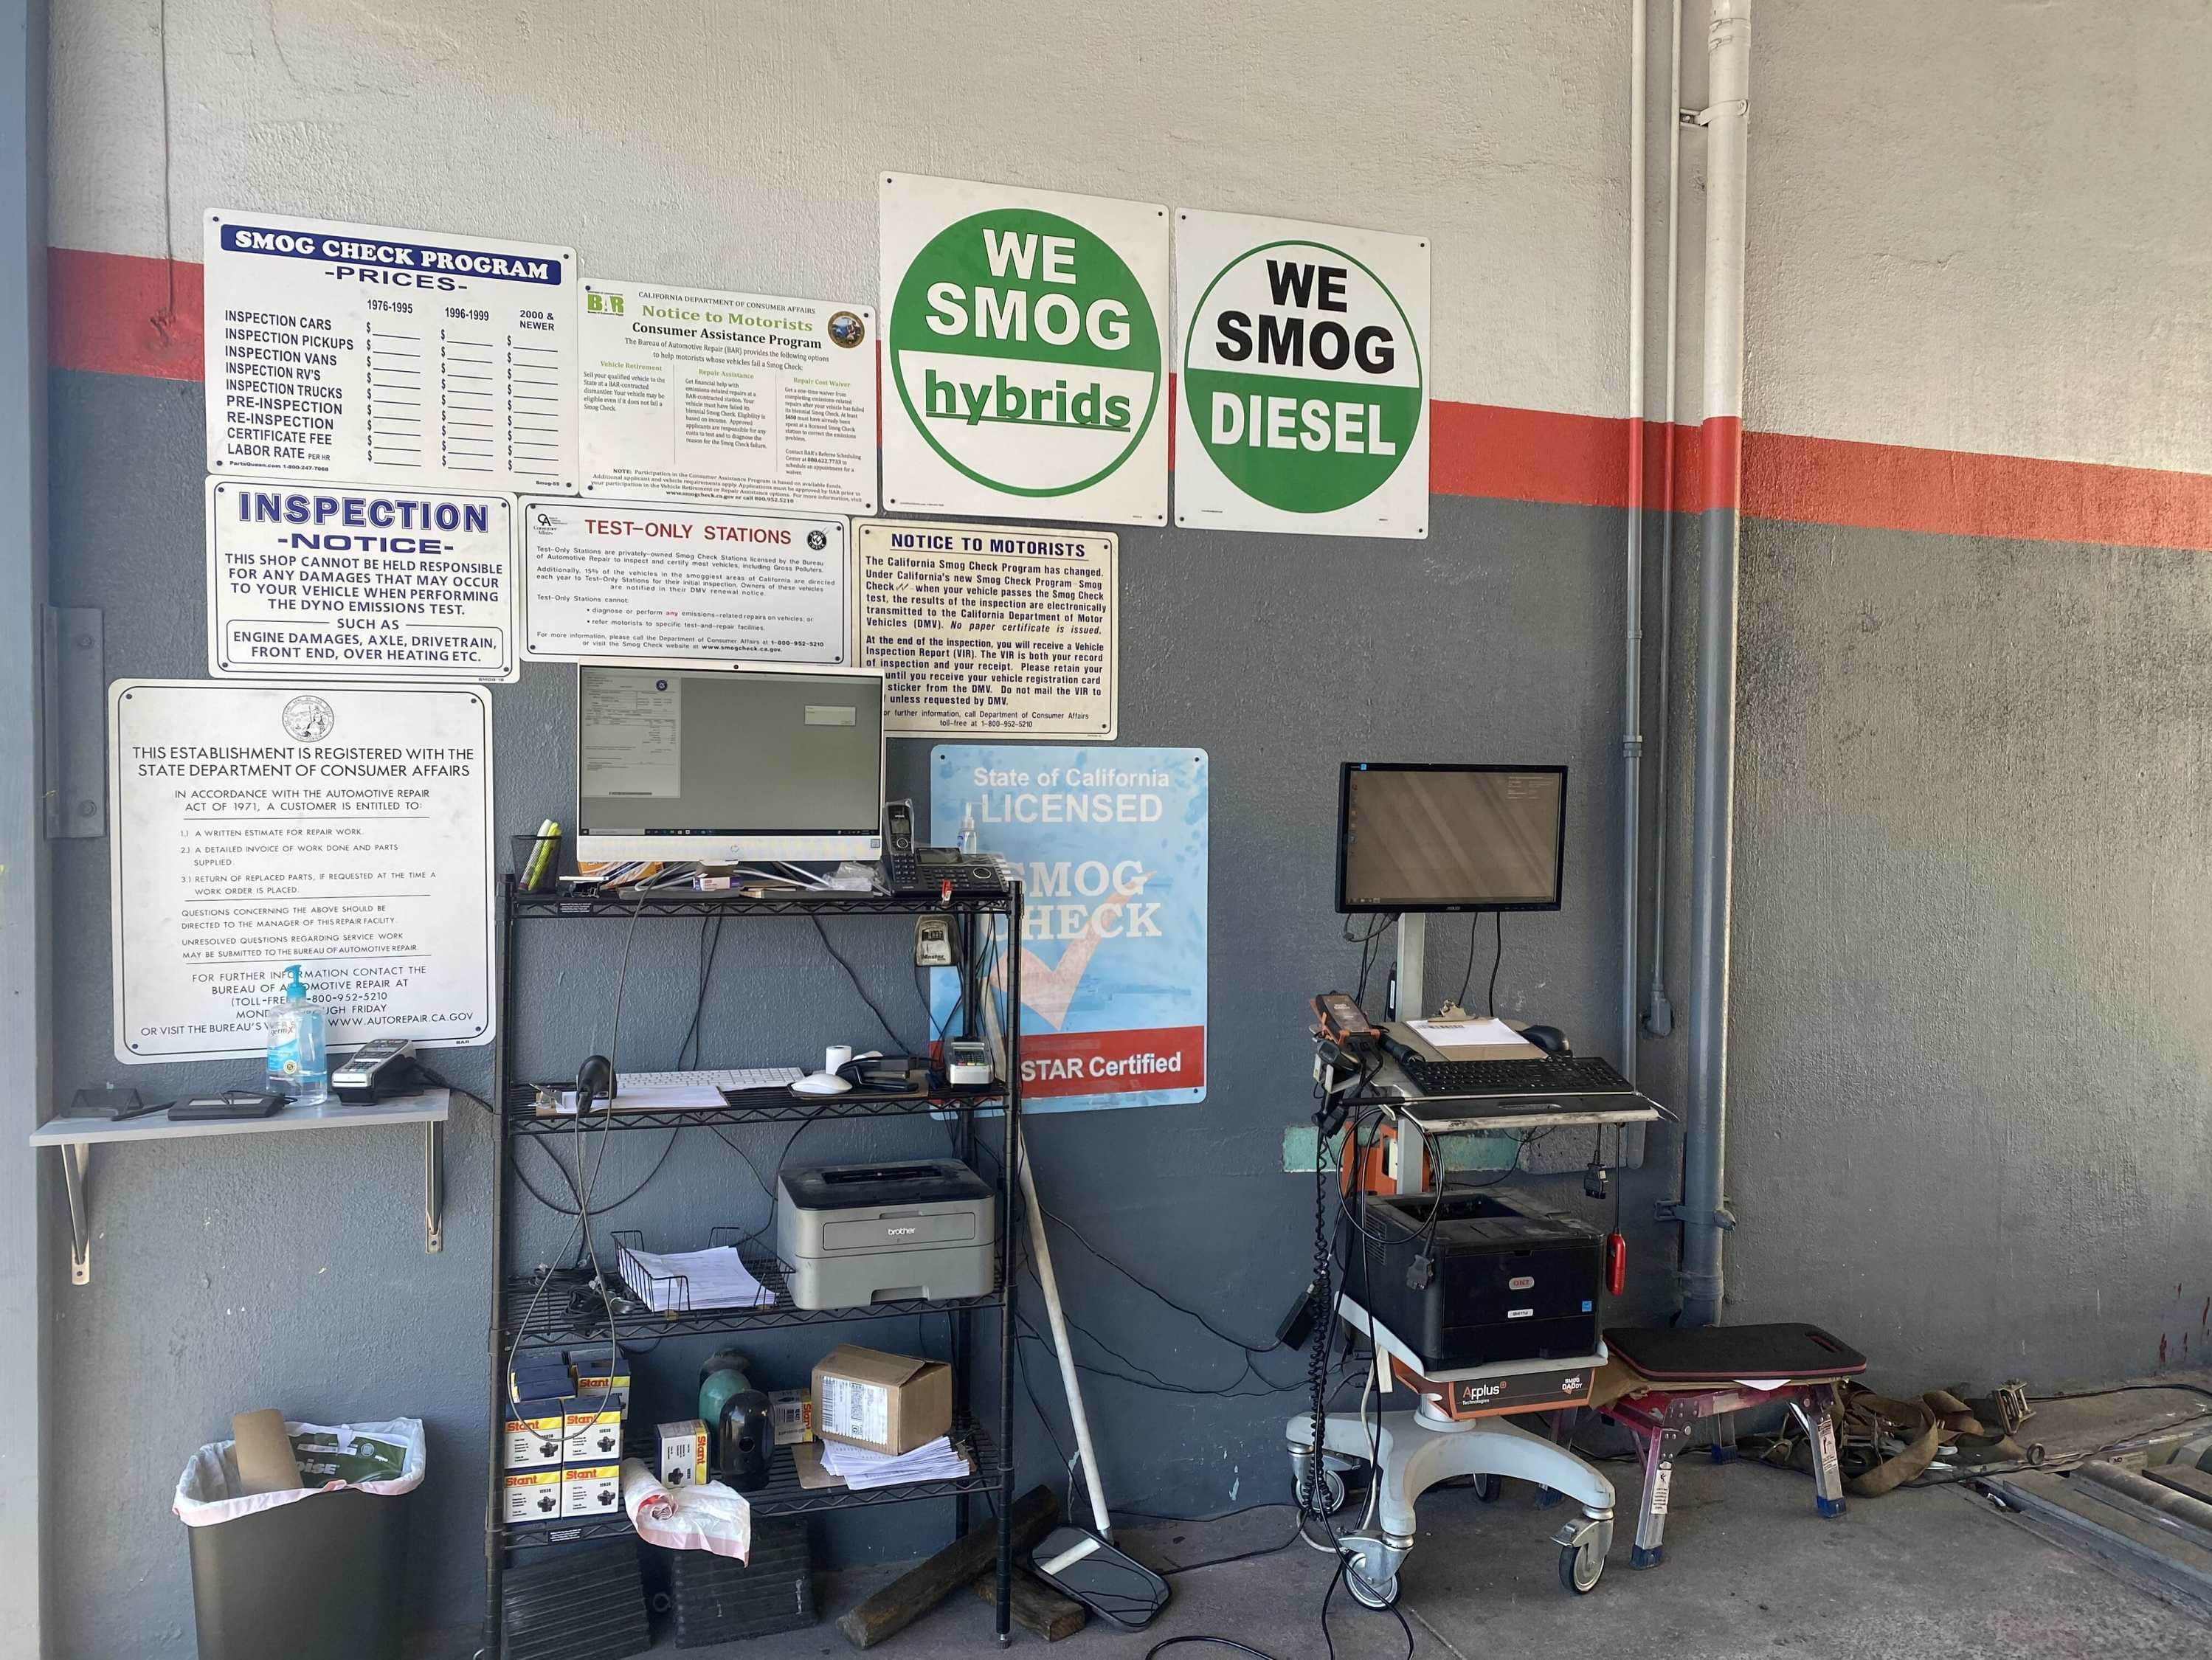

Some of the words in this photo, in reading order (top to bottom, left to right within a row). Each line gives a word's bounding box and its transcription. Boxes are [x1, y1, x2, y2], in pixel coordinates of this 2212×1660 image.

[235, 231, 315, 254] SMOG
[322, 240, 414, 265] CHECK
[421, 251, 547, 279] PROGRAM
[983, 229, 1076, 284] WE
[325, 266, 466, 291] -PRICES-
[1266, 260, 1347, 313] WE
[367, 299, 412, 313] 1976-1995
[639, 291, 682, 301] CALIFORNIA
[685, 296, 733, 305] DEPARTMENT
[747, 302, 785, 311] CONSUMER
[226, 310, 295, 327] INSPECTION
[300, 317, 331, 330] CARS
[445, 307, 488, 321] 1996-1999
[520, 310, 543, 319] 2000
[643, 305, 699, 320] Notice
[706, 312, 722, 322] to
[729, 314, 812, 331] Motorists
[926, 283, 1130, 350] SMOG
[520, 320, 554, 331] NEWER
[226, 328, 298, 345] INSPECTION
[303, 335, 353, 350] PICKUPS
[633, 322, 697, 336] Consumer
[700, 328, 765, 343] Assistance
[770, 334, 820, 349] Program
[1216, 311, 1394, 374] SMOG
[226, 345, 300, 362] INSPECTION
[305, 353, 336, 365] VANS
[226, 362, 292, 378] INSPECTION
[297, 368, 320, 380] RV'S
[626, 362, 661, 371] Retirement
[227, 379, 294, 395] INSPECTION
[297, 384, 342, 398] TRUCKS
[227, 395, 342, 414] PRE-INSPECTION
[926, 370, 1130, 432] hybrids
[227, 412, 333, 429] RE-INSPECTION
[1212, 392, 1395, 455] DIESEL
[227, 427, 305, 443] CERTIFICATE
[310, 433, 331, 445] FEE
[228, 443, 270, 456] LABOR
[274, 446, 304, 458] RATE
[239, 491, 488, 533] INSPECTION
[584, 519, 692, 538] TEST-ONLY
[705, 526, 791, 544] STATIONS
[278, 533, 453, 554] -NOTICE-
[892, 533, 953, 549] NOTICE
[961, 537, 981, 551] TO
[990, 539, 1085, 557] MOTORISTS
[225, 553, 255, 564] THIS
[260, 555, 296, 565] SHOP
[301, 556, 359, 568] CANNOT
[364, 559, 378, 569] BE
[383, 560, 415, 570] HELD
[421, 561, 502, 574] RESPONSIBLE
[866, 556, 882, 565] The
[888, 557, 934, 567] California
[939, 559, 964, 571] Smog
[970, 561, 998, 571] Check
[1002, 563, 1040, 573] Program
[1045, 565, 1060, 574] has
[1064, 567, 1102, 577] changed.
[229, 568, 257, 578] FOR
[263, 570, 294, 580] ANY
[300, 571, 370, 583] DAMAGES
[376, 574, 412, 584] THAT
[417, 575, 447, 586] MAY
[453, 576, 498, 587] OCCUR
[537, 594, 570, 602] Test-Only
[337, 618, 375, 629] SUCH
[381, 620, 398, 629] AS
[234, 632, 283, 642] ENGINE
[289, 633, 362, 646] DAMAGES,
[368, 635, 407, 646] AXLE,
[412, 636, 496, 649] DRIVETRAIN,
[252, 646, 300, 657] FRONT
[306, 648, 338, 660] END,
[344, 649, 382, 659] OVER
[387, 650, 448, 660] HEATING
[453, 651, 480, 661] ETC.
[132, 747, 165, 758] THIS
[171, 747, 294, 758] ESTABLISHMENT
[299, 747, 311, 759] IS
[315, 748, 401, 759] REGISTERED
[406, 748, 443, 759] WITH
[448, 749, 473, 759] THE
[139, 764, 184, 776] STATE
[190, 764, 291, 775] DEPARTMENT
[295, 764, 316, 776] OF
[321, 764, 407, 776] CONSUMER
[412, 765, 469, 776] AFFAIRS
[974, 768, 1029, 787] State
[1037, 768, 1060, 786] of
[1065, 767, 1169, 787] California
[272, 789, 298, 798] WITH
[303, 789, 320, 798] THE
[326, 789, 393, 798] AUTOMOTIVE
[982, 794, 1163, 823] LICENSED
[1021, 1058, 1083, 1082] STAR
[1089, 1051, 1181, 1076] Certified
[580, 1379, 609, 1388] Stant
[1463, 1384, 1500, 1400] Applus
[507, 1422, 539, 1431] Stant
[567, 1413, 598, 1425] Stant
[697, 1436, 706, 1464] Stant
[506, 1476, 537, 1486] Stant
[566, 1470, 597, 1479] Stant
